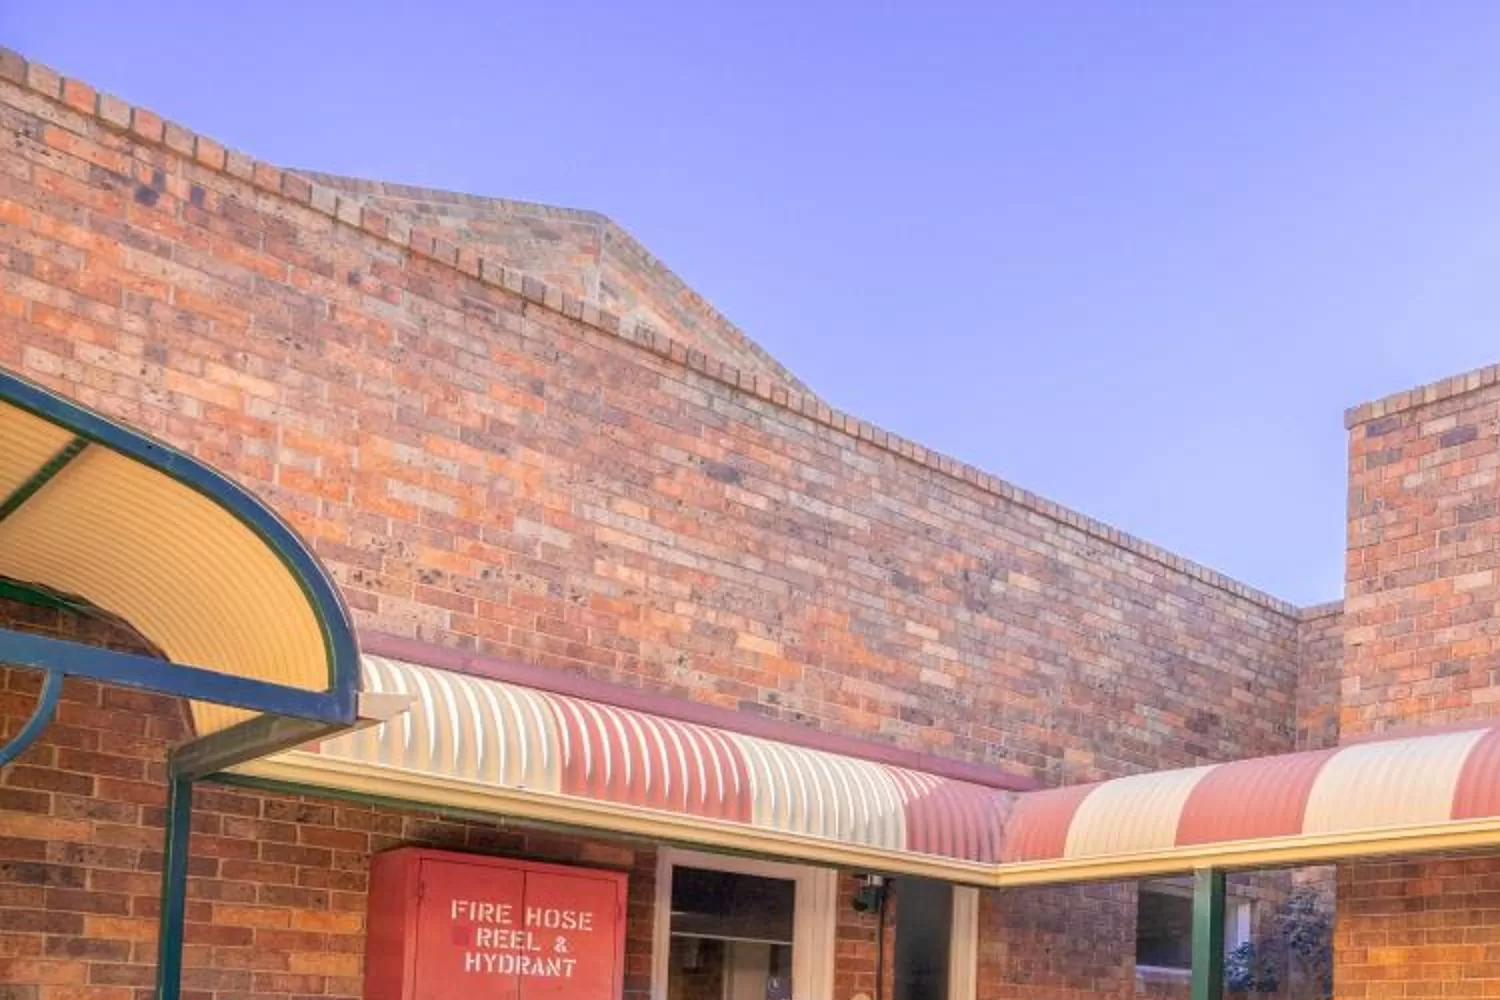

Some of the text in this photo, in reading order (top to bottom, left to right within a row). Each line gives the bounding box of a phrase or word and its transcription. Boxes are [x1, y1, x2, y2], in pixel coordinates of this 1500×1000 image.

[451, 900, 593, 931] FIRE HOSE
[476, 928, 568, 953] REEL &
[465, 952, 576, 977] HYDRANT
